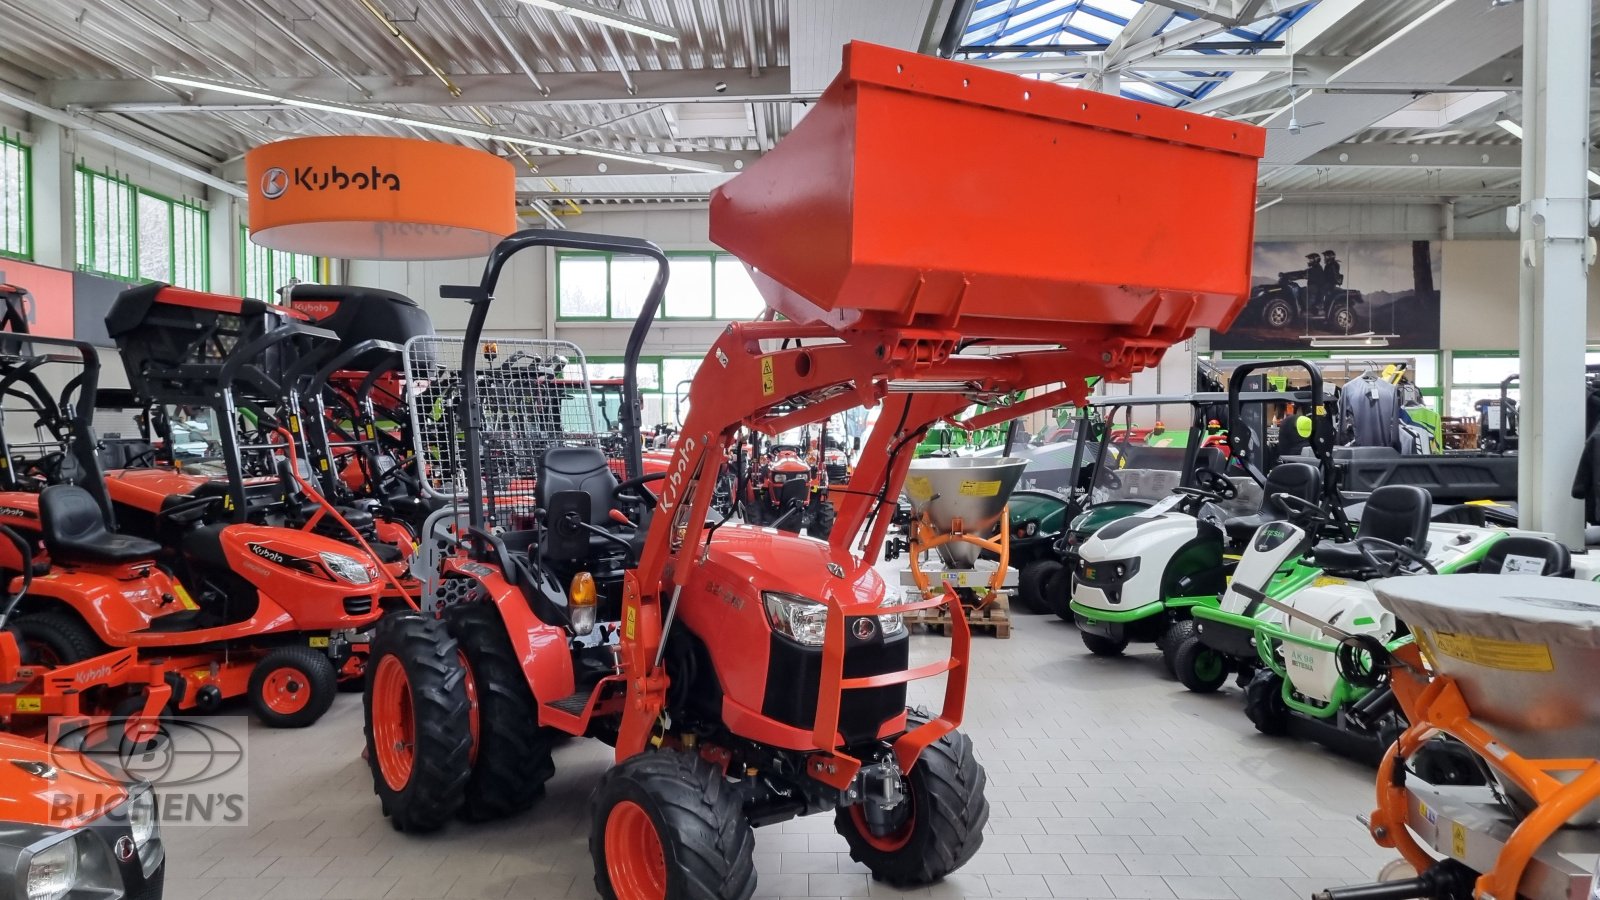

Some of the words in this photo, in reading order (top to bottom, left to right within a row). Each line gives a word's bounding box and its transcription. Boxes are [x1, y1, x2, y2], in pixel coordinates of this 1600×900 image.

[294, 165, 401, 192] Kubota
[294, 303, 330, 312] Kubota
[659, 437, 696, 515] Kubota
[0, 506, 24, 517] ubota
[252, 544, 283, 563] Kubota
[75, 664, 112, 684] Kubota
